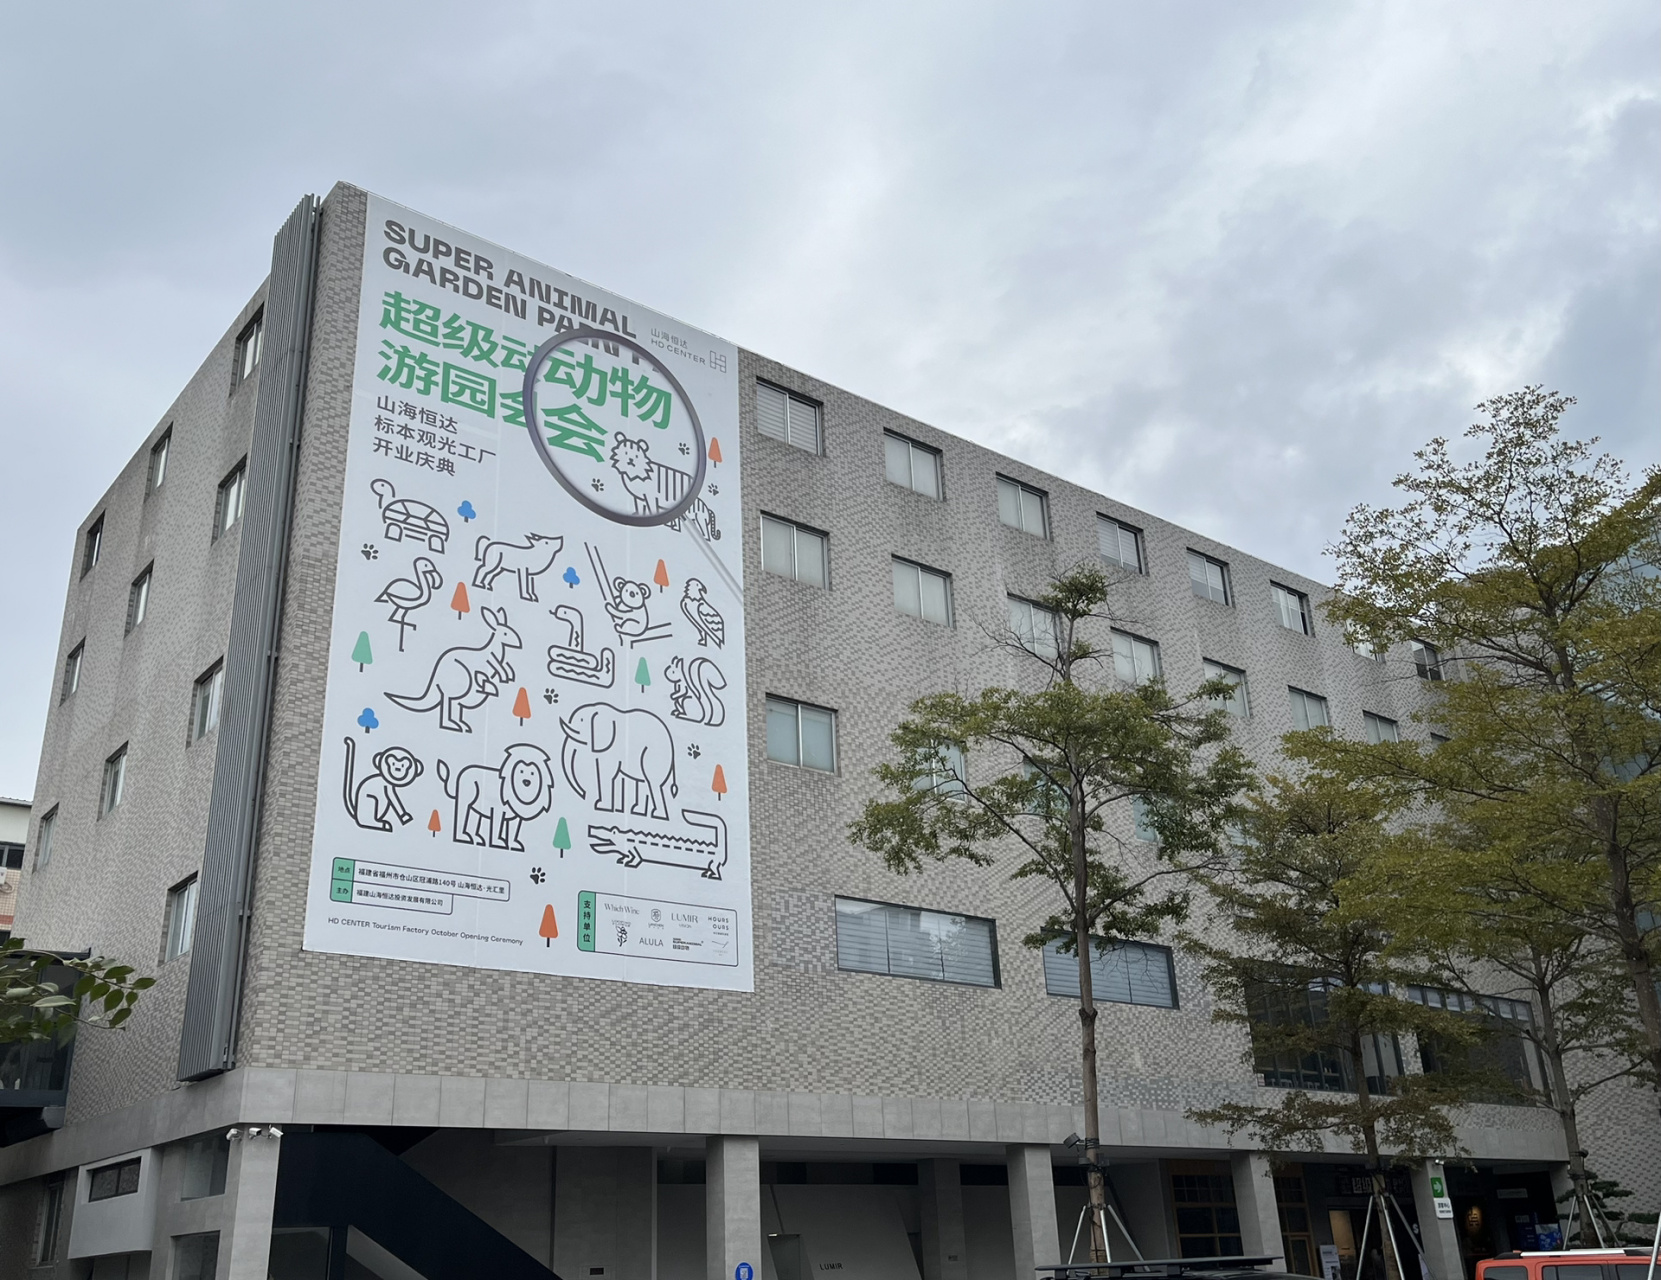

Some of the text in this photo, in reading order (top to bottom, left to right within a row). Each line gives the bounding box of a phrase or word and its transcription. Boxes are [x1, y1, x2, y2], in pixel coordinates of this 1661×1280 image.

[382, 246, 527, 320] GARDEN
[383, 219, 637, 339] SUPER ANIMAL
[650, 327, 688, 350] 山海恒达
[651, 338, 665, 349] HD
[666, 344, 706, 366] CENTER
[376, 395, 458, 435] 山海恒达
[374, 414, 496, 464] 标本观光工厂
[372, 436, 456, 477] 开业庆典
[337, 866, 350, 875] 地点
[336, 886, 349, 895] 主办
[583, 900, 591, 943] 支持单位
[671, 912, 699, 924] LUMIR
[707, 916, 729, 924] HOURS
[712, 923, 729, 931] OURS
[328, 917, 524, 946] HD CENTER Tourism Factory October Opening Ceremony
[639, 937, 664, 947] ALULA
[819, 1262, 844, 1271] LUMIR
